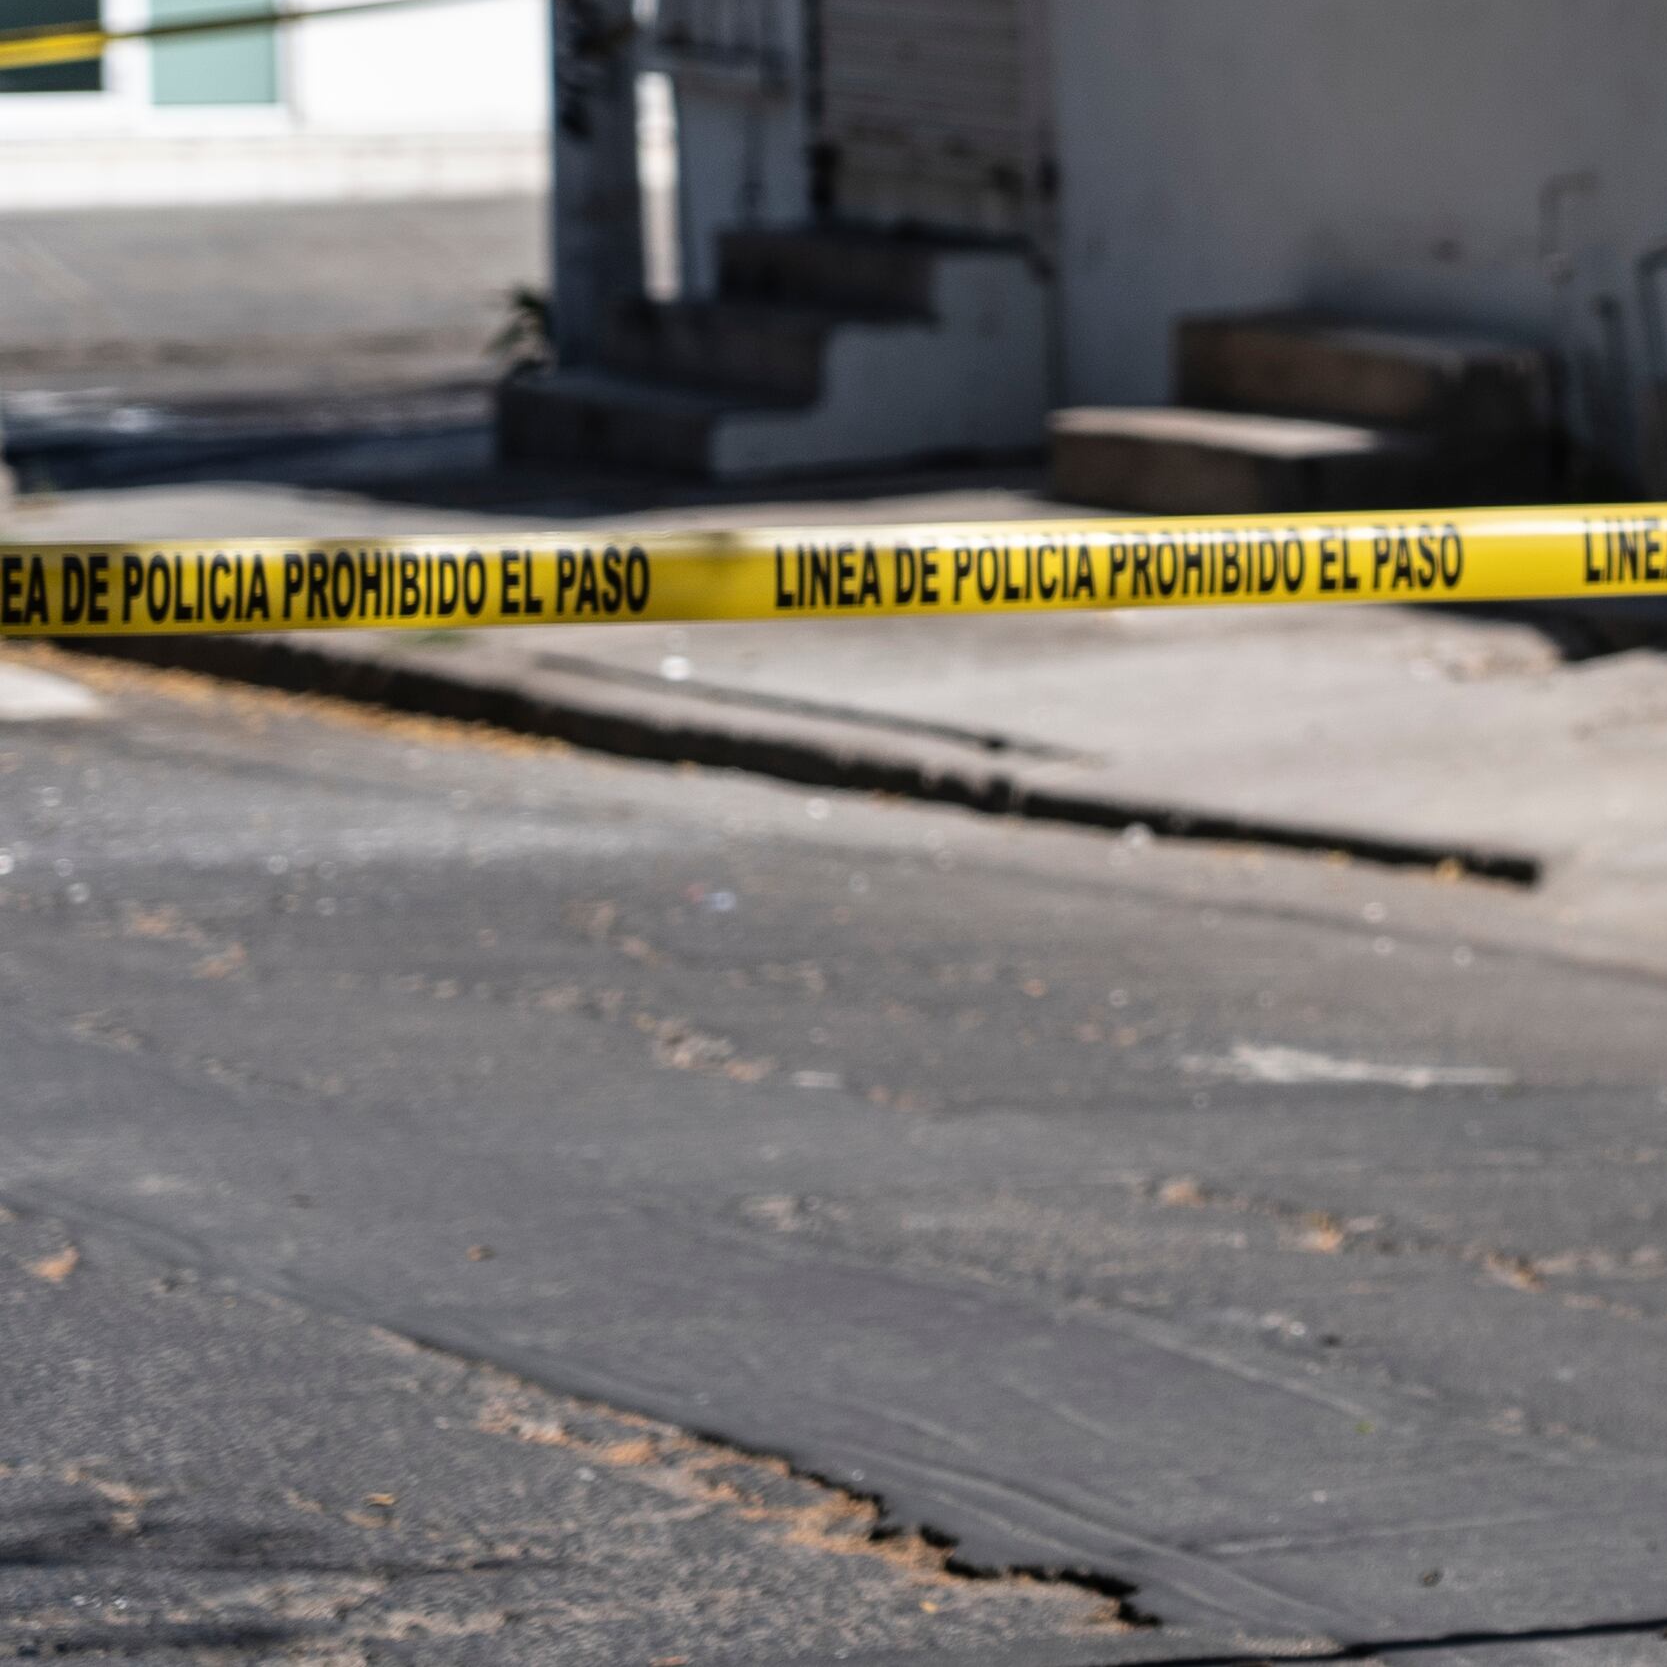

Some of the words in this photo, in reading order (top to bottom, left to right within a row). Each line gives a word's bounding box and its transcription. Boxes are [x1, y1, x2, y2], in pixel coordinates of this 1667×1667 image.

[62, 554, 110, 624] DE
[122, 552, 271, 624] POLICIA
[281, 547, 488, 622] PROHIBIDO
[501, 547, 543, 615] EL
[555, 544, 651, 614] PASO
[774, 540, 882, 609] LINEA
[895, 540, 939, 605] DE
[953, 537, 1096, 602] POLICIA
[1108, 529, 1302, 598] PROHIBIDO
[1318, 527, 1358, 591] EL
[1372, 523, 1464, 589] PASO
